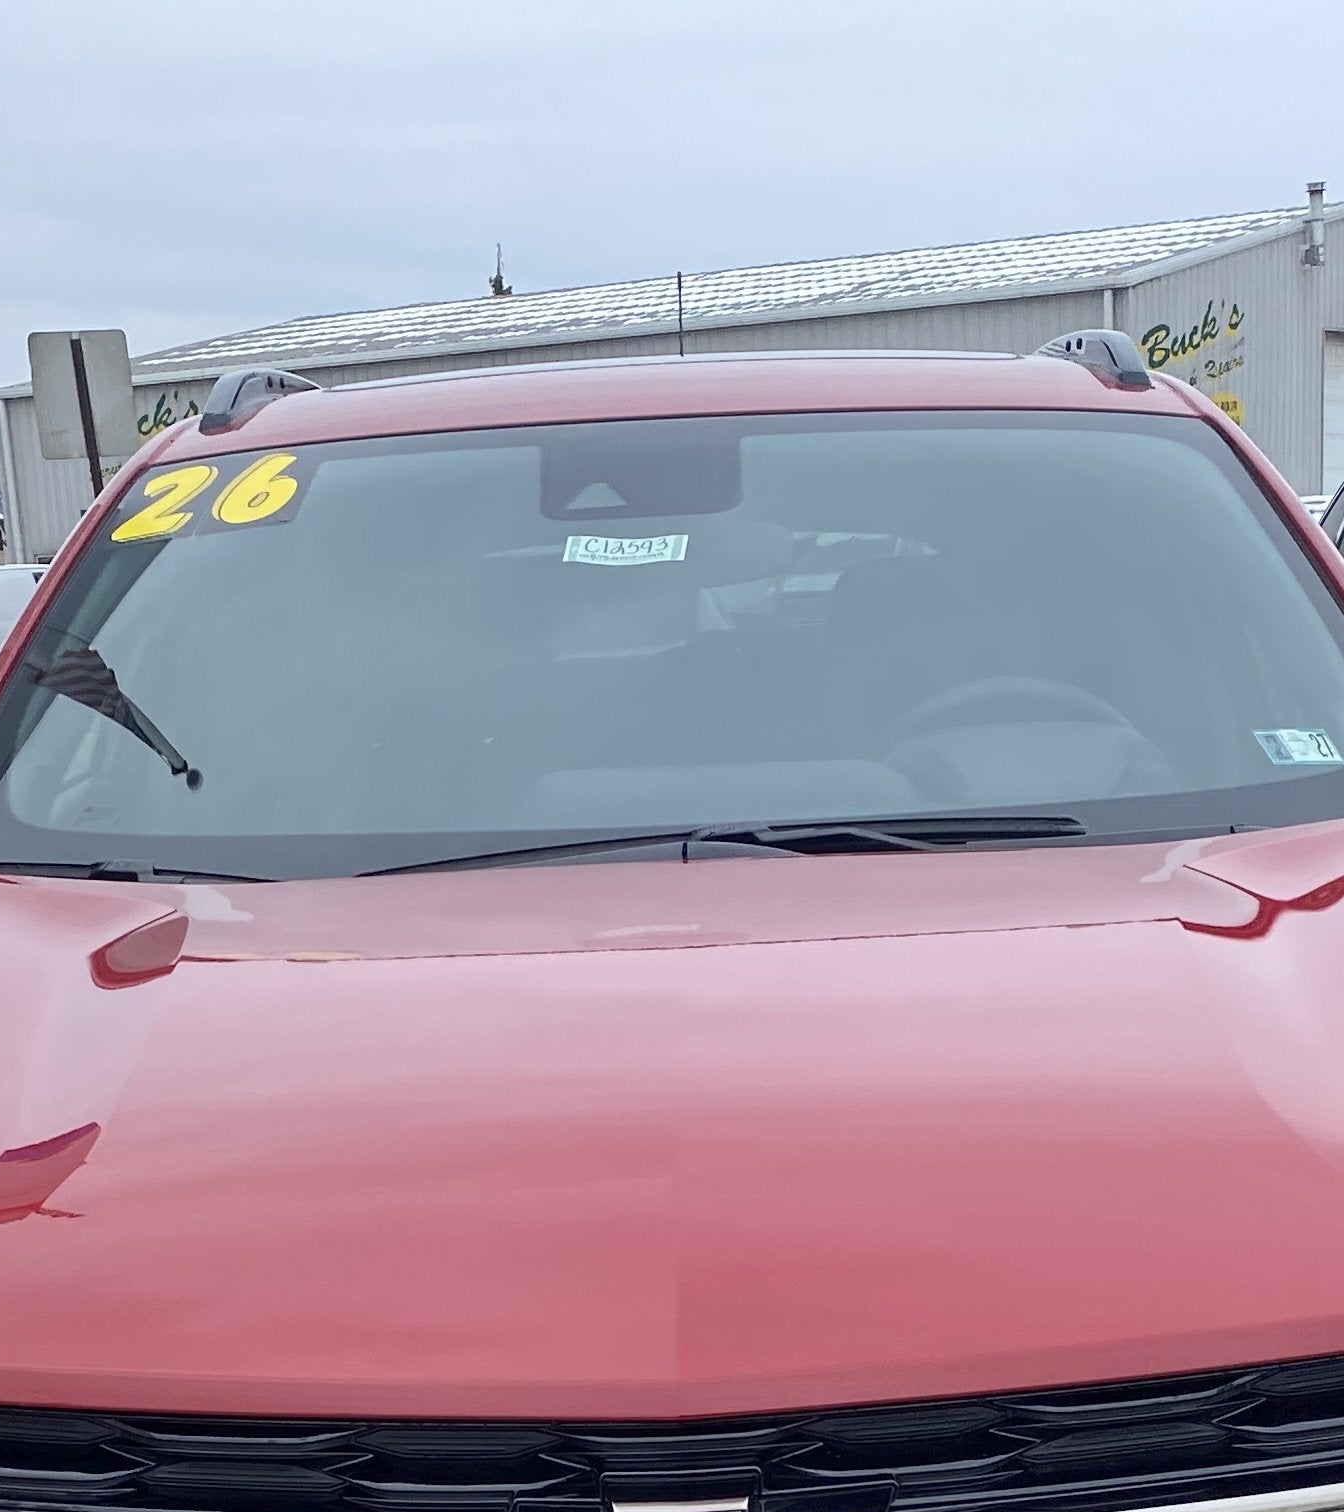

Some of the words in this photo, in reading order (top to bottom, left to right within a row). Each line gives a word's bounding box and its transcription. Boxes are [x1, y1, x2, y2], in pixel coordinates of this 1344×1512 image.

[1141, 299, 1245, 369] Buck's
[110, 453, 298, 543] 26
[584, 537, 668, 555] C12593
